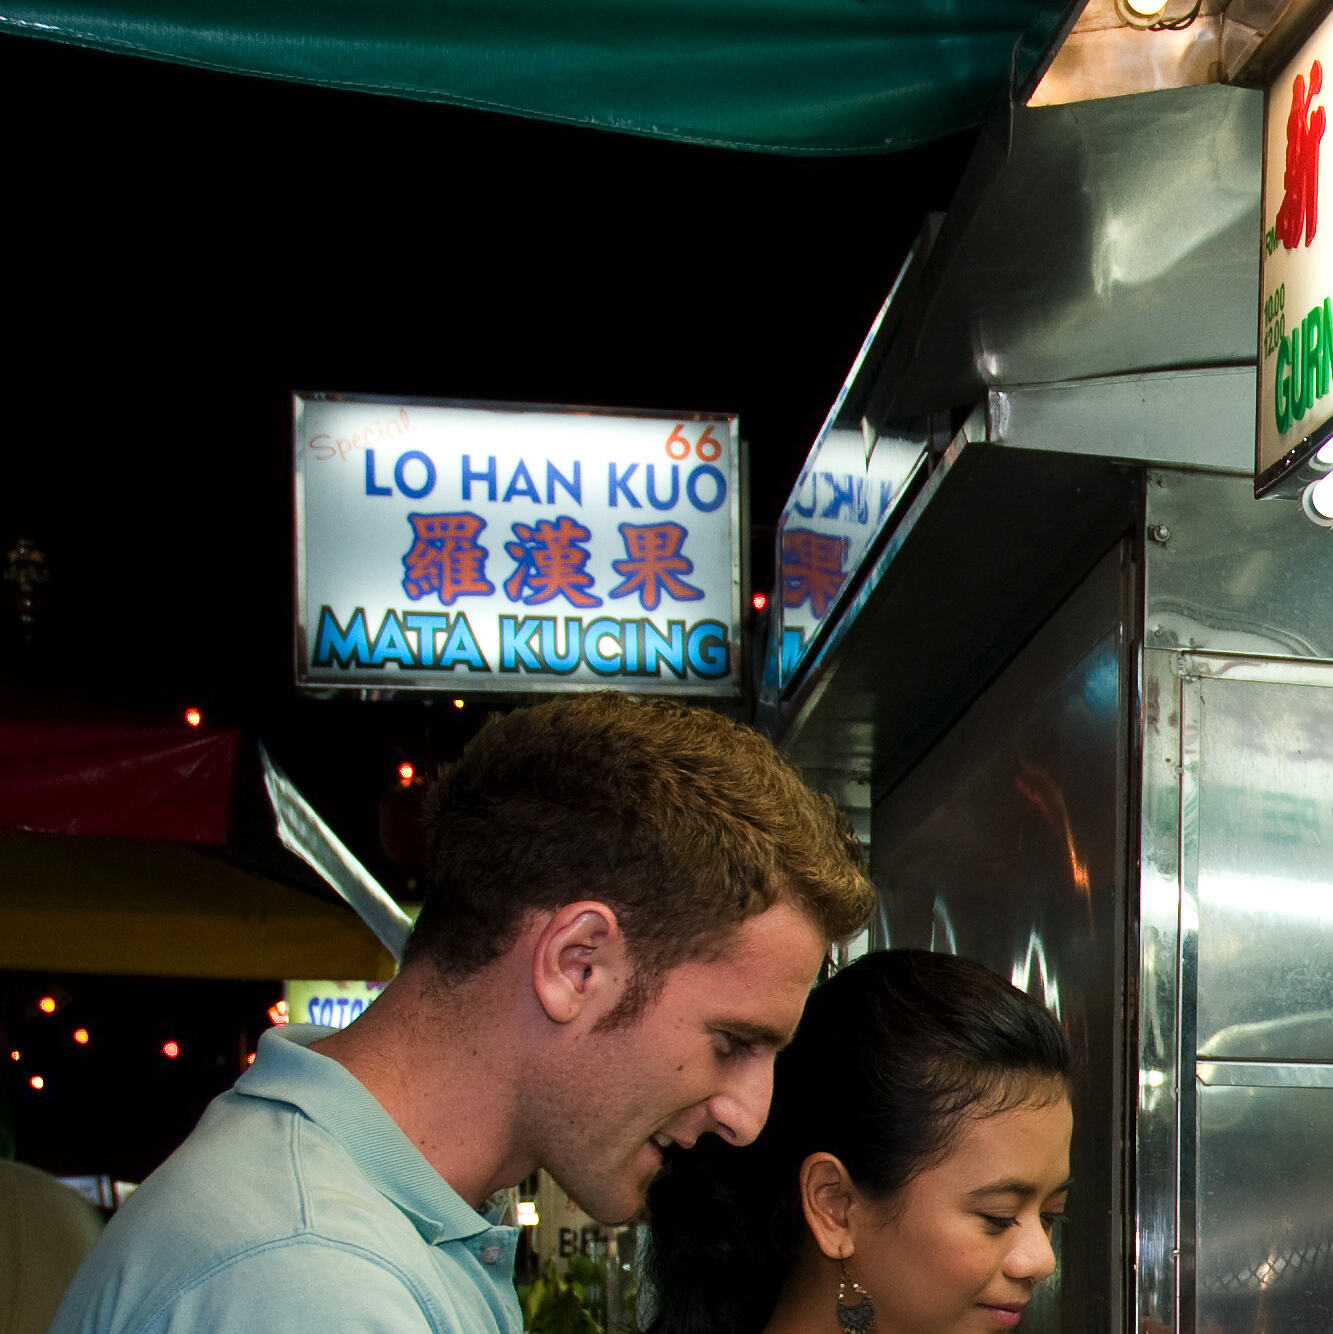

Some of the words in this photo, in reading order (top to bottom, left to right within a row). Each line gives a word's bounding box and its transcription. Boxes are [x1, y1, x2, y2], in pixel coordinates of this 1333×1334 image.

[1264, 282, 1285, 328] 10.00
[1264, 312, 1285, 360] 12.00
[308, 408, 417, 461] Special
[665, 424, 722, 462] 66
[364, 448, 436, 499] LO
[461, 454, 582, 506] HAN
[608, 462, 727, 512] KUO
[401, 511, 705, 611] 羅漢果
[312, 604, 493, 673] MATA
[498, 613, 731, 680] KUCING
[308, 996, 374, 1030] SOTO
